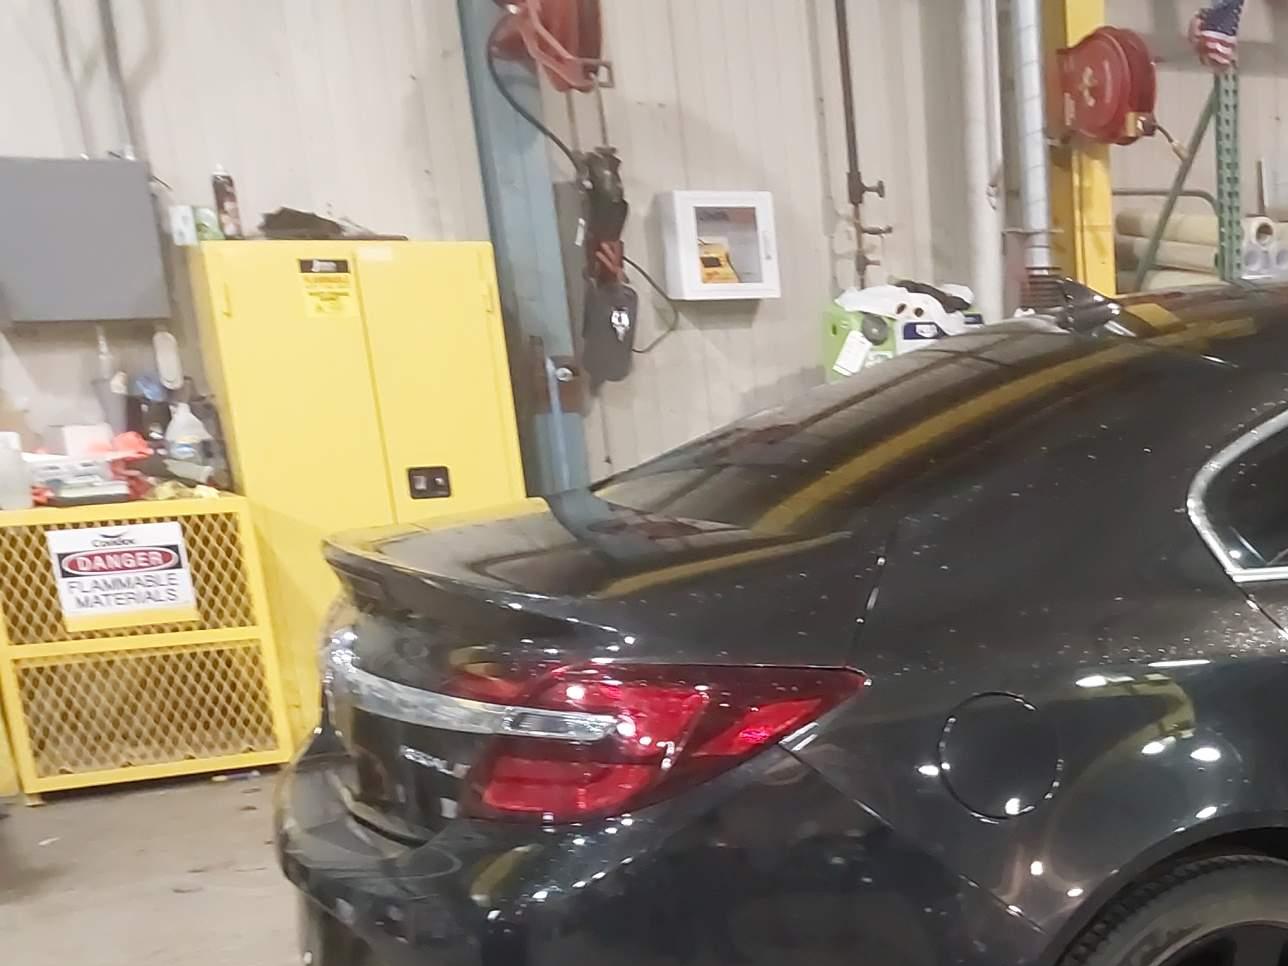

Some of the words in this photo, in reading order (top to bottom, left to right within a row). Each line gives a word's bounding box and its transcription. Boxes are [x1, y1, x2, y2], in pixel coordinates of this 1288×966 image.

[75, 551, 164, 571] DANGER
[67, 572, 179, 595] FLAMMABLE
[75, 587, 178, 609] MATERIALS
